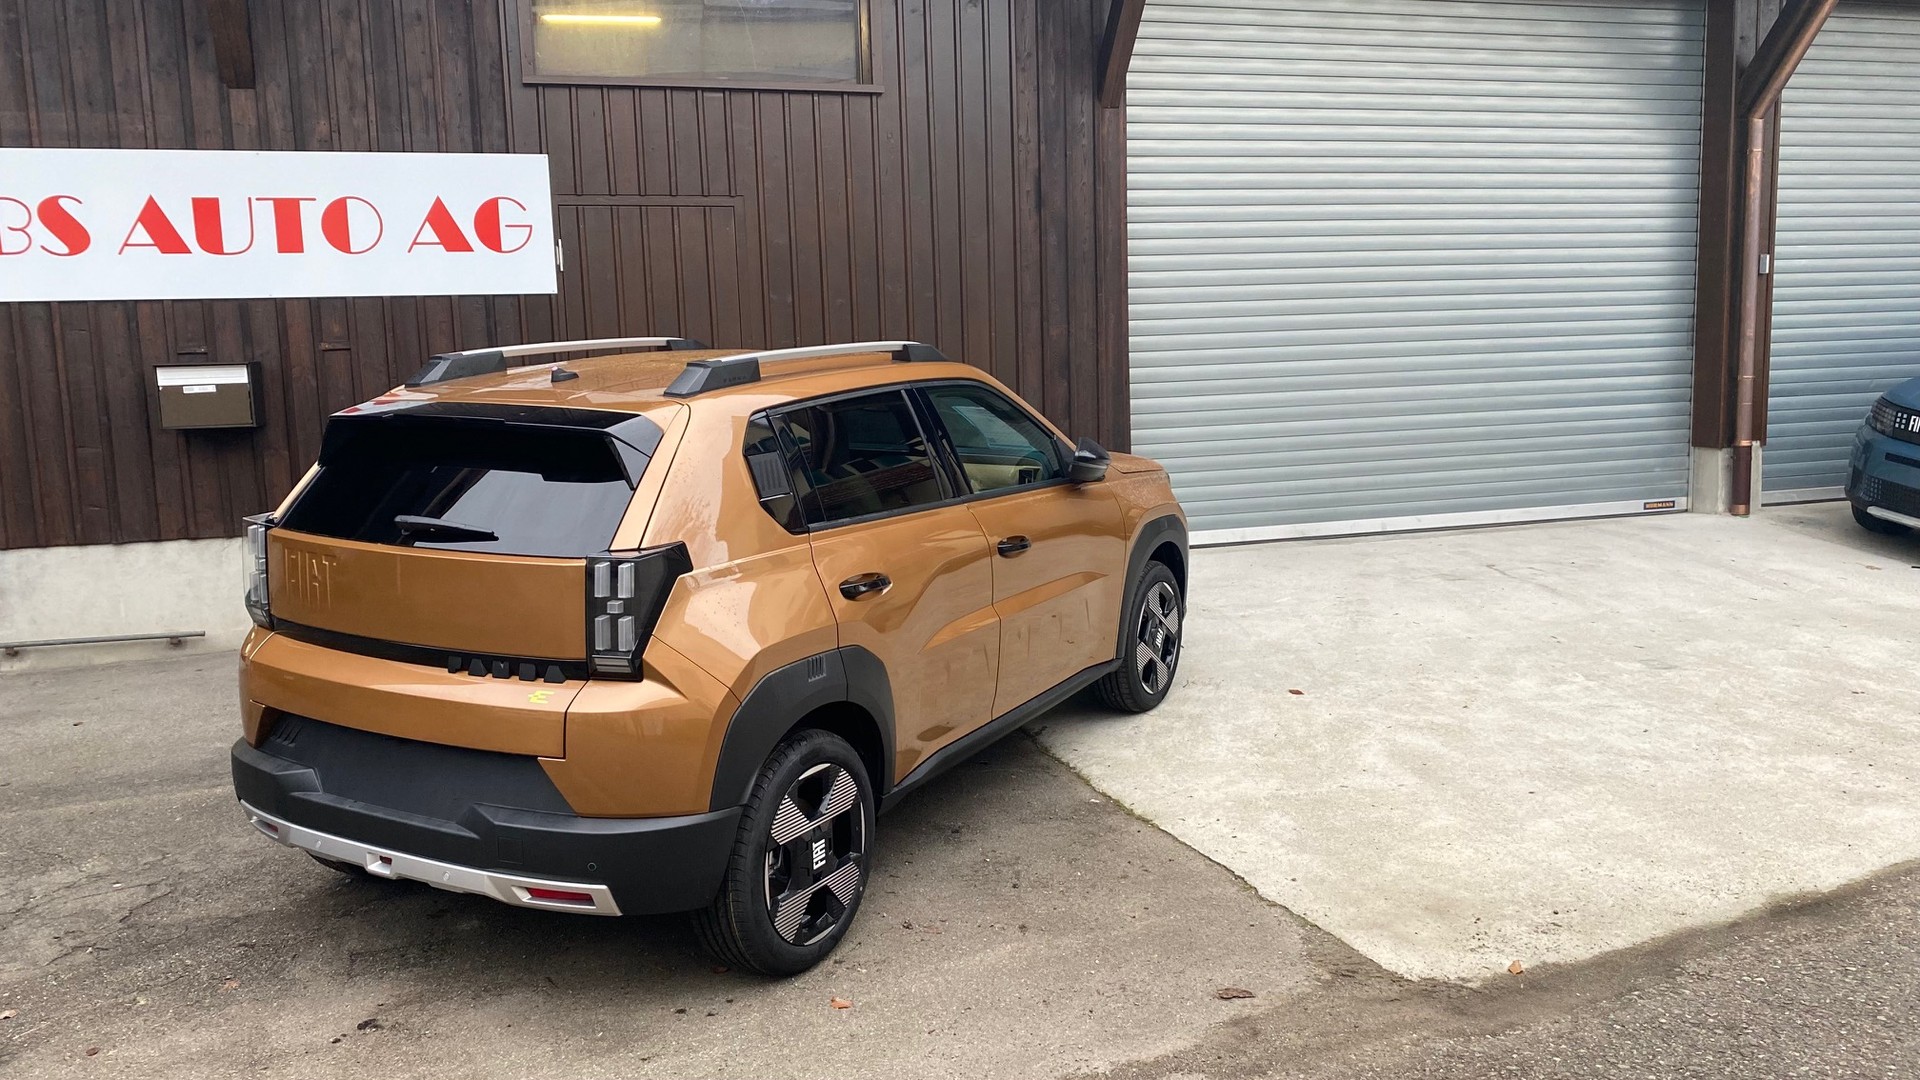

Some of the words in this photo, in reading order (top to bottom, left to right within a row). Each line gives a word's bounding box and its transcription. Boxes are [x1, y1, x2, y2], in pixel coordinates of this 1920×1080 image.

[118, 194, 383, 256] AUTO
[407, 195, 533, 254] AG
[284, 547, 338, 610] FIAT
[1155, 627, 1164, 649] FIAT
[812, 838, 826, 870] FIAT
